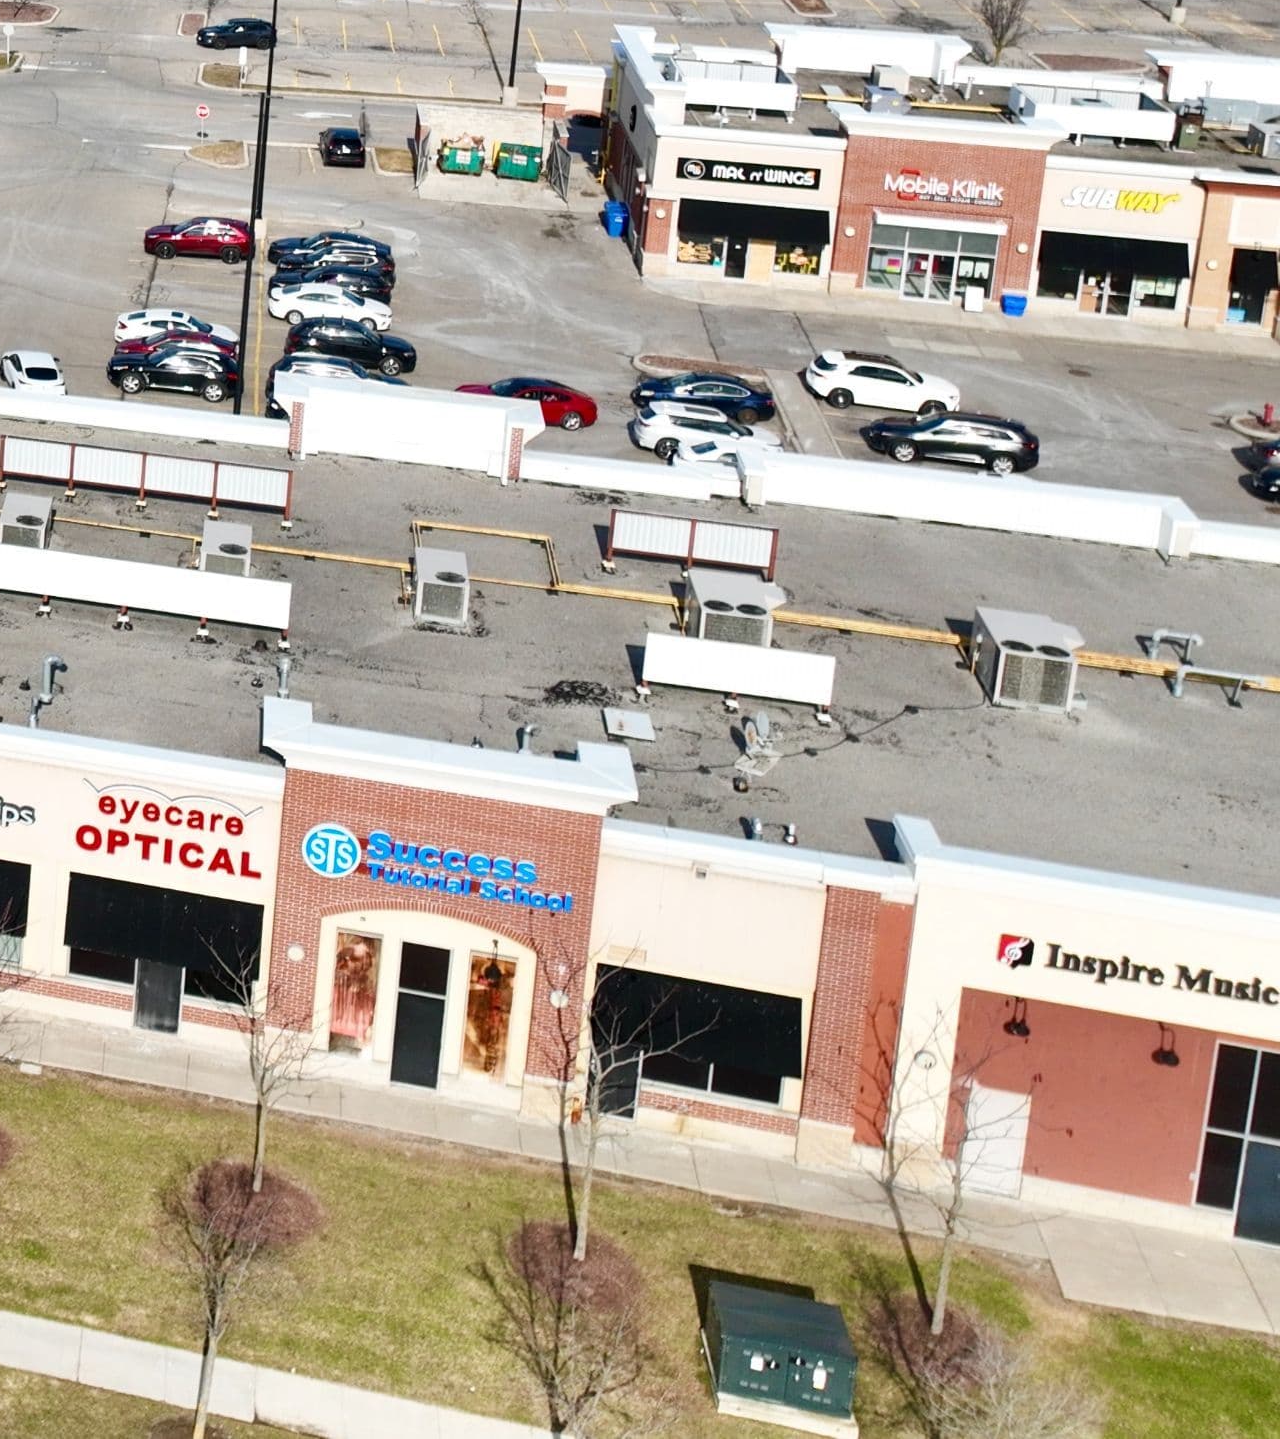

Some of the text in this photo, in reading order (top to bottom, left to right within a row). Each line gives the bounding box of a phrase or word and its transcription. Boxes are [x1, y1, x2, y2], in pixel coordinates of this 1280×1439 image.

[763, 168, 816, 186] WINGS
[884, 173, 1005, 202] Mobile Klinik
[1062, 185, 1182, 214] SUBWAY
[97, 793, 245, 837] eyecare
[75, 824, 262, 880] OPTICAL
[366, 829, 538, 885] Success
[366, 860, 574, 913] Tutorial School
[1044, 942, 1280, 1005] Inspire Music
